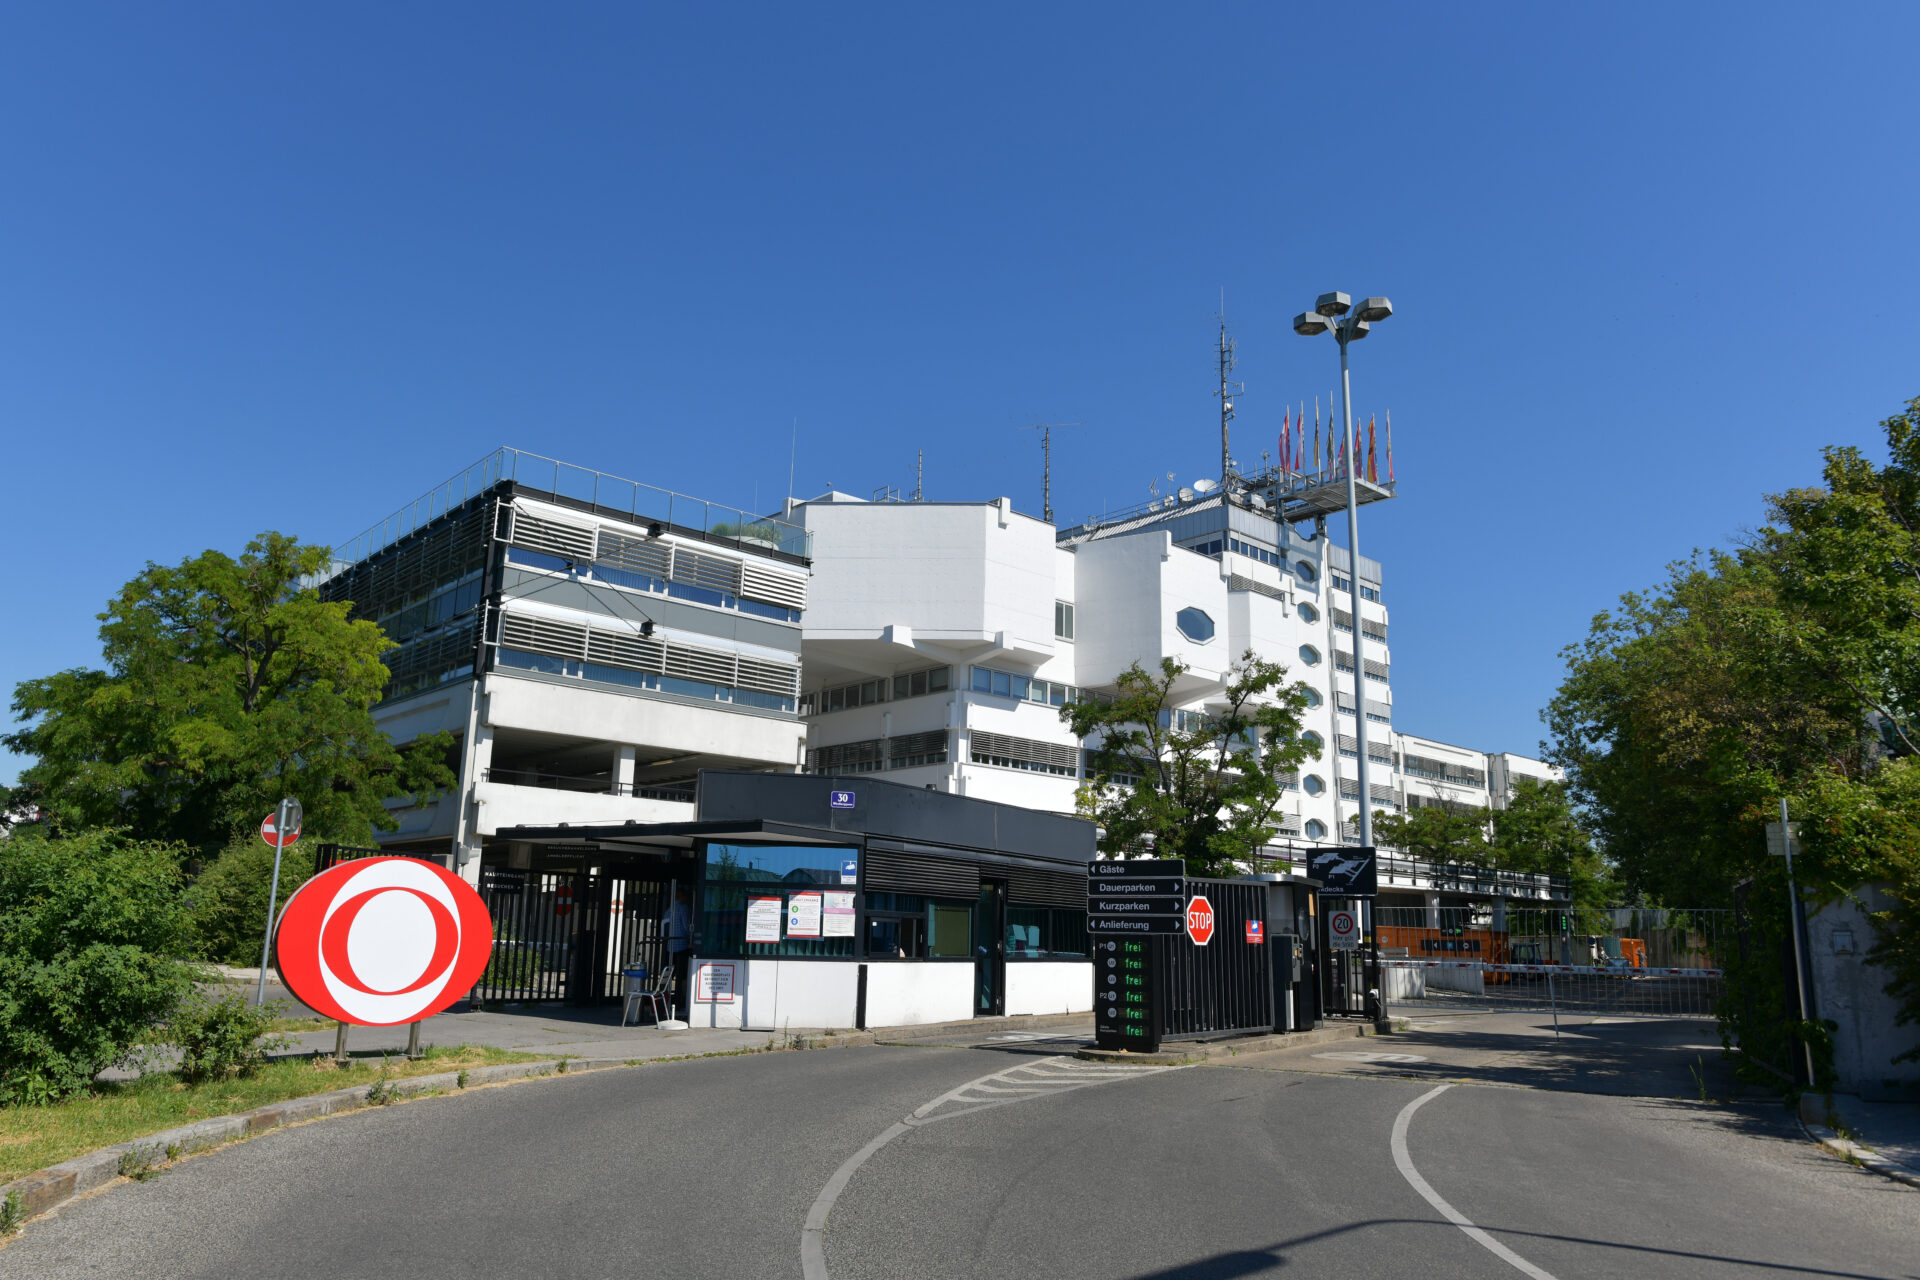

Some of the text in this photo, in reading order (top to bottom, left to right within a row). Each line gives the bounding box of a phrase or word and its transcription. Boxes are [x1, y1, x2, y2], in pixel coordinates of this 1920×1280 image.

[837, 793, 849, 803] 30
[1099, 865, 1125, 874] Gäste
[1099, 883, 1156, 894] Dauerparken
[1099, 901, 1150, 912] Kurzparken
[1099, 920, 1150, 931] Anlieferung
[1189, 912, 1212, 930] STOP
[1337, 918, 1349, 929] 20
[1125, 942, 1142, 952] frei
[1125, 958, 1142, 969] frei
[1125, 974, 1142, 985] frei
[1126, 991, 1142, 1002] frei
[1126, 1007, 1143, 1019] frei
[1126, 1024, 1143, 1036] frei
